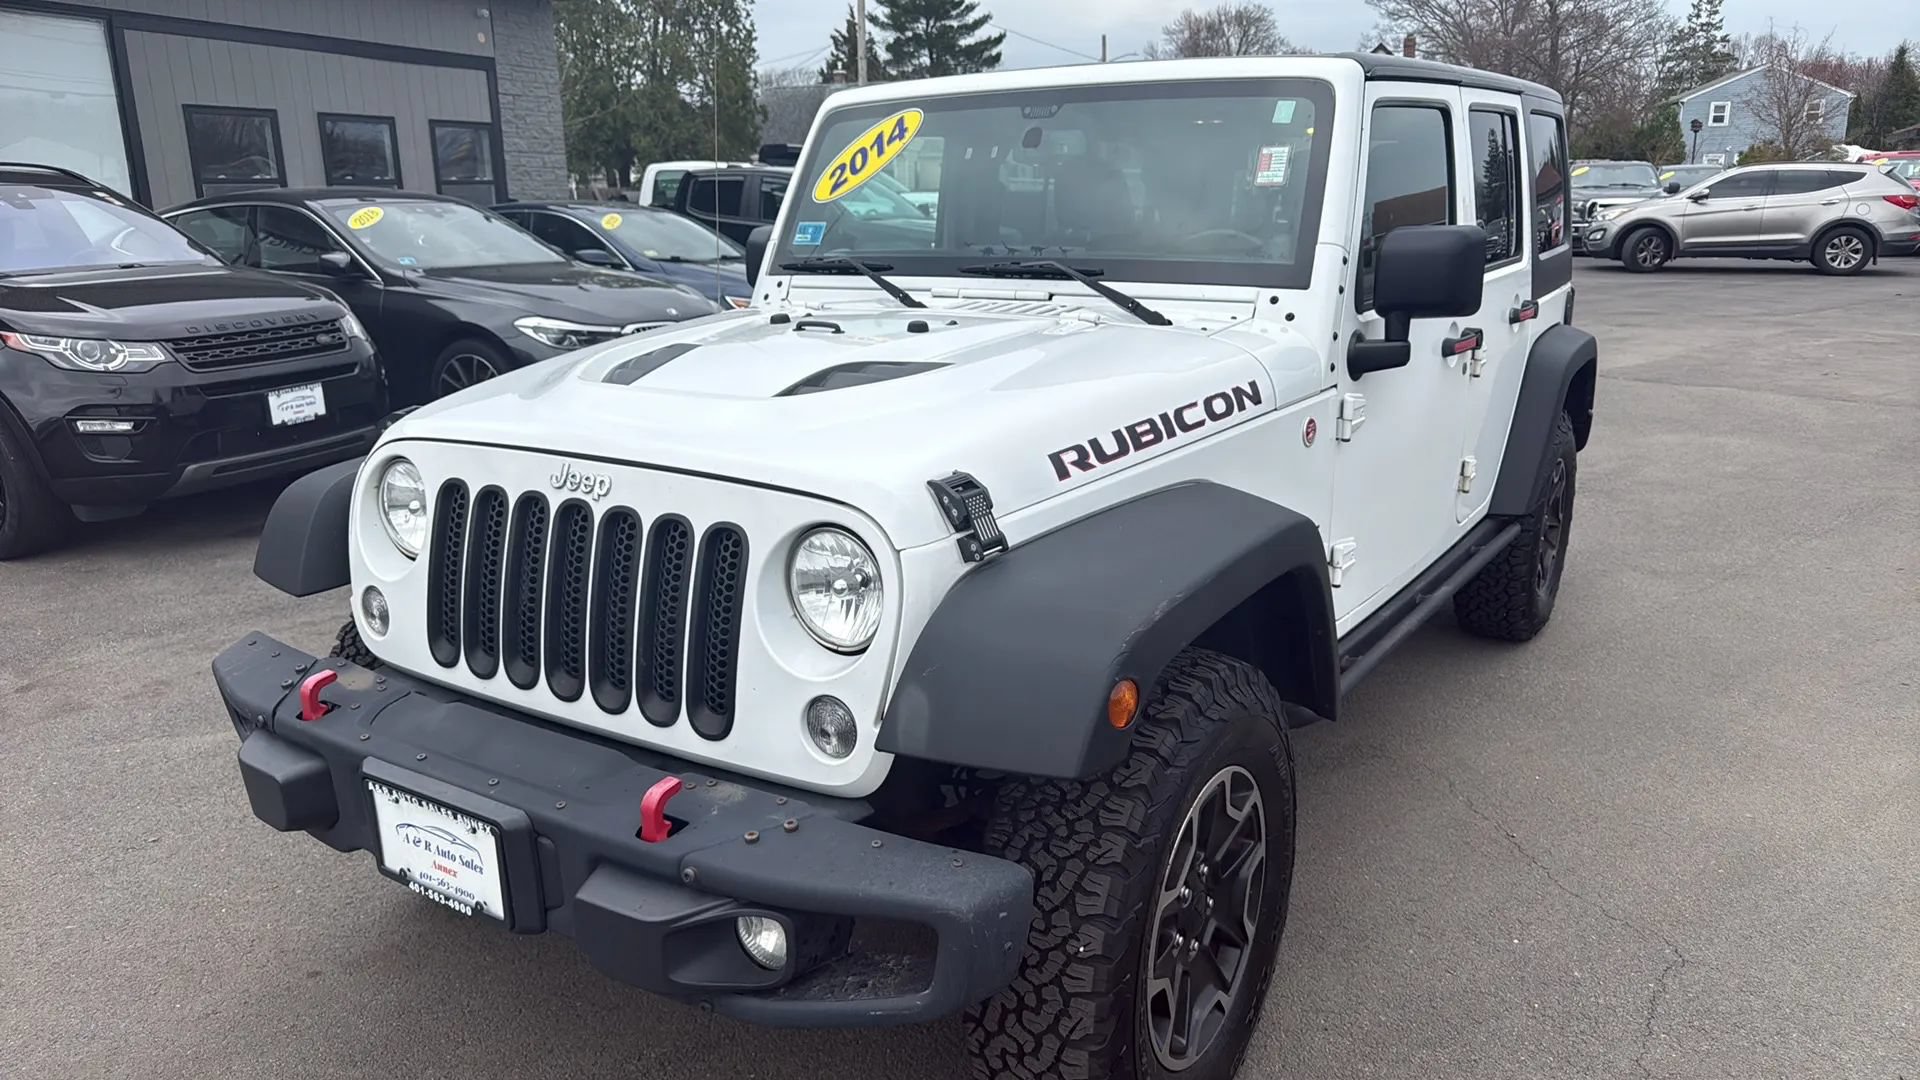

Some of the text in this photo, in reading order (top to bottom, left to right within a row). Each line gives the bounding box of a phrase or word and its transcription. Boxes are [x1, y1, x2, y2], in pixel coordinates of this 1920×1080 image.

[828, 115, 909, 196] 2014
[184, 312, 319, 335] DISCOVERY
[1047, 379, 1263, 482] RUBICON
[550, 462, 612, 502] Jeep
[402, 832, 410, 844] A
[424, 840, 432, 853] R
[433, 845, 457, 863] Auto
[458, 854, 484, 875] Sales
[431, 860, 458, 878] Annex
[408, 881, 472, 916] 401-563-4900
[419, 871, 475, 900] 401-563-4900
